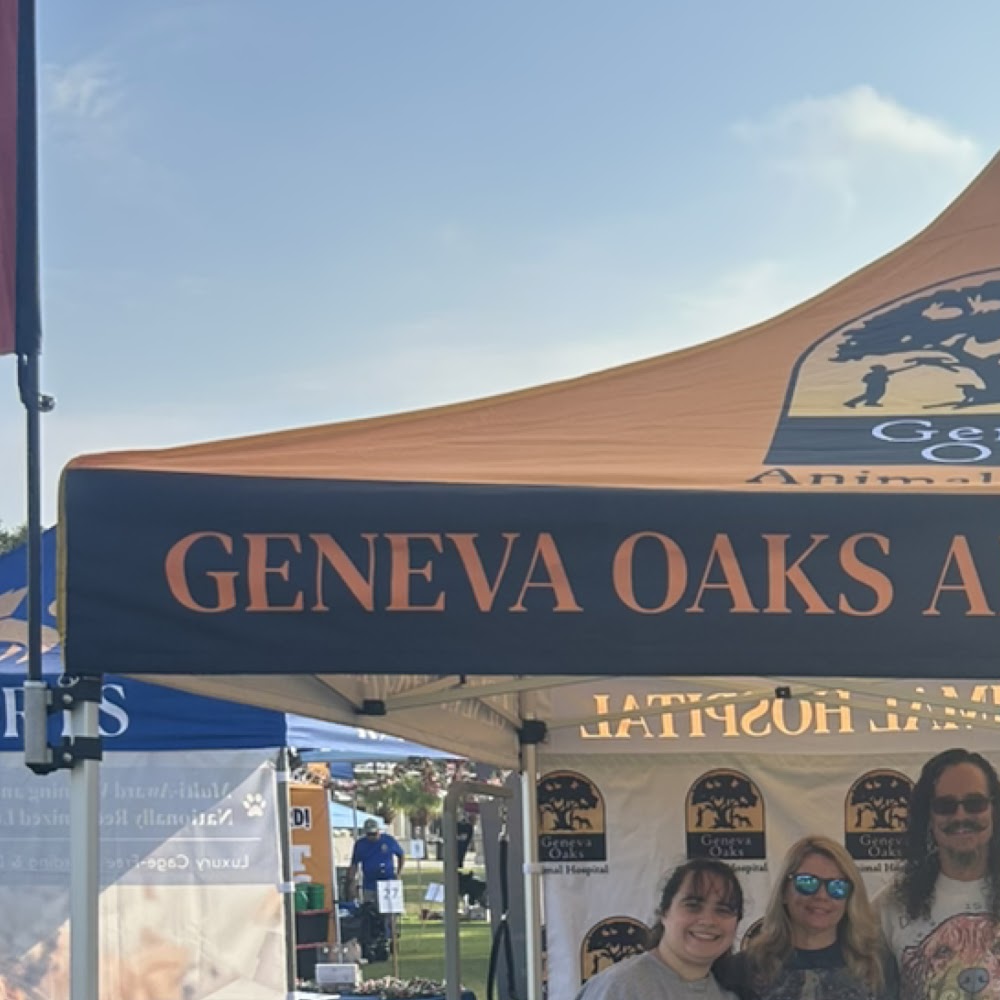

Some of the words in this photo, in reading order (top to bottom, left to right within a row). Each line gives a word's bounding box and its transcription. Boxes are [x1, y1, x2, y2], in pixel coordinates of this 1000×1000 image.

[744, 468, 993, 486] Animal
[164, 530, 584, 615] GENEVA
[612, 531, 894, 617] OAKS
[541, 836, 592, 848] Geneva
[701, 834, 751, 847] Geneva
[548, 848, 585, 859] Oaks
[708, 846, 745, 858] Oaks
[565, 863, 609, 876] Hospital
[384, 887, 400, 900] 27
